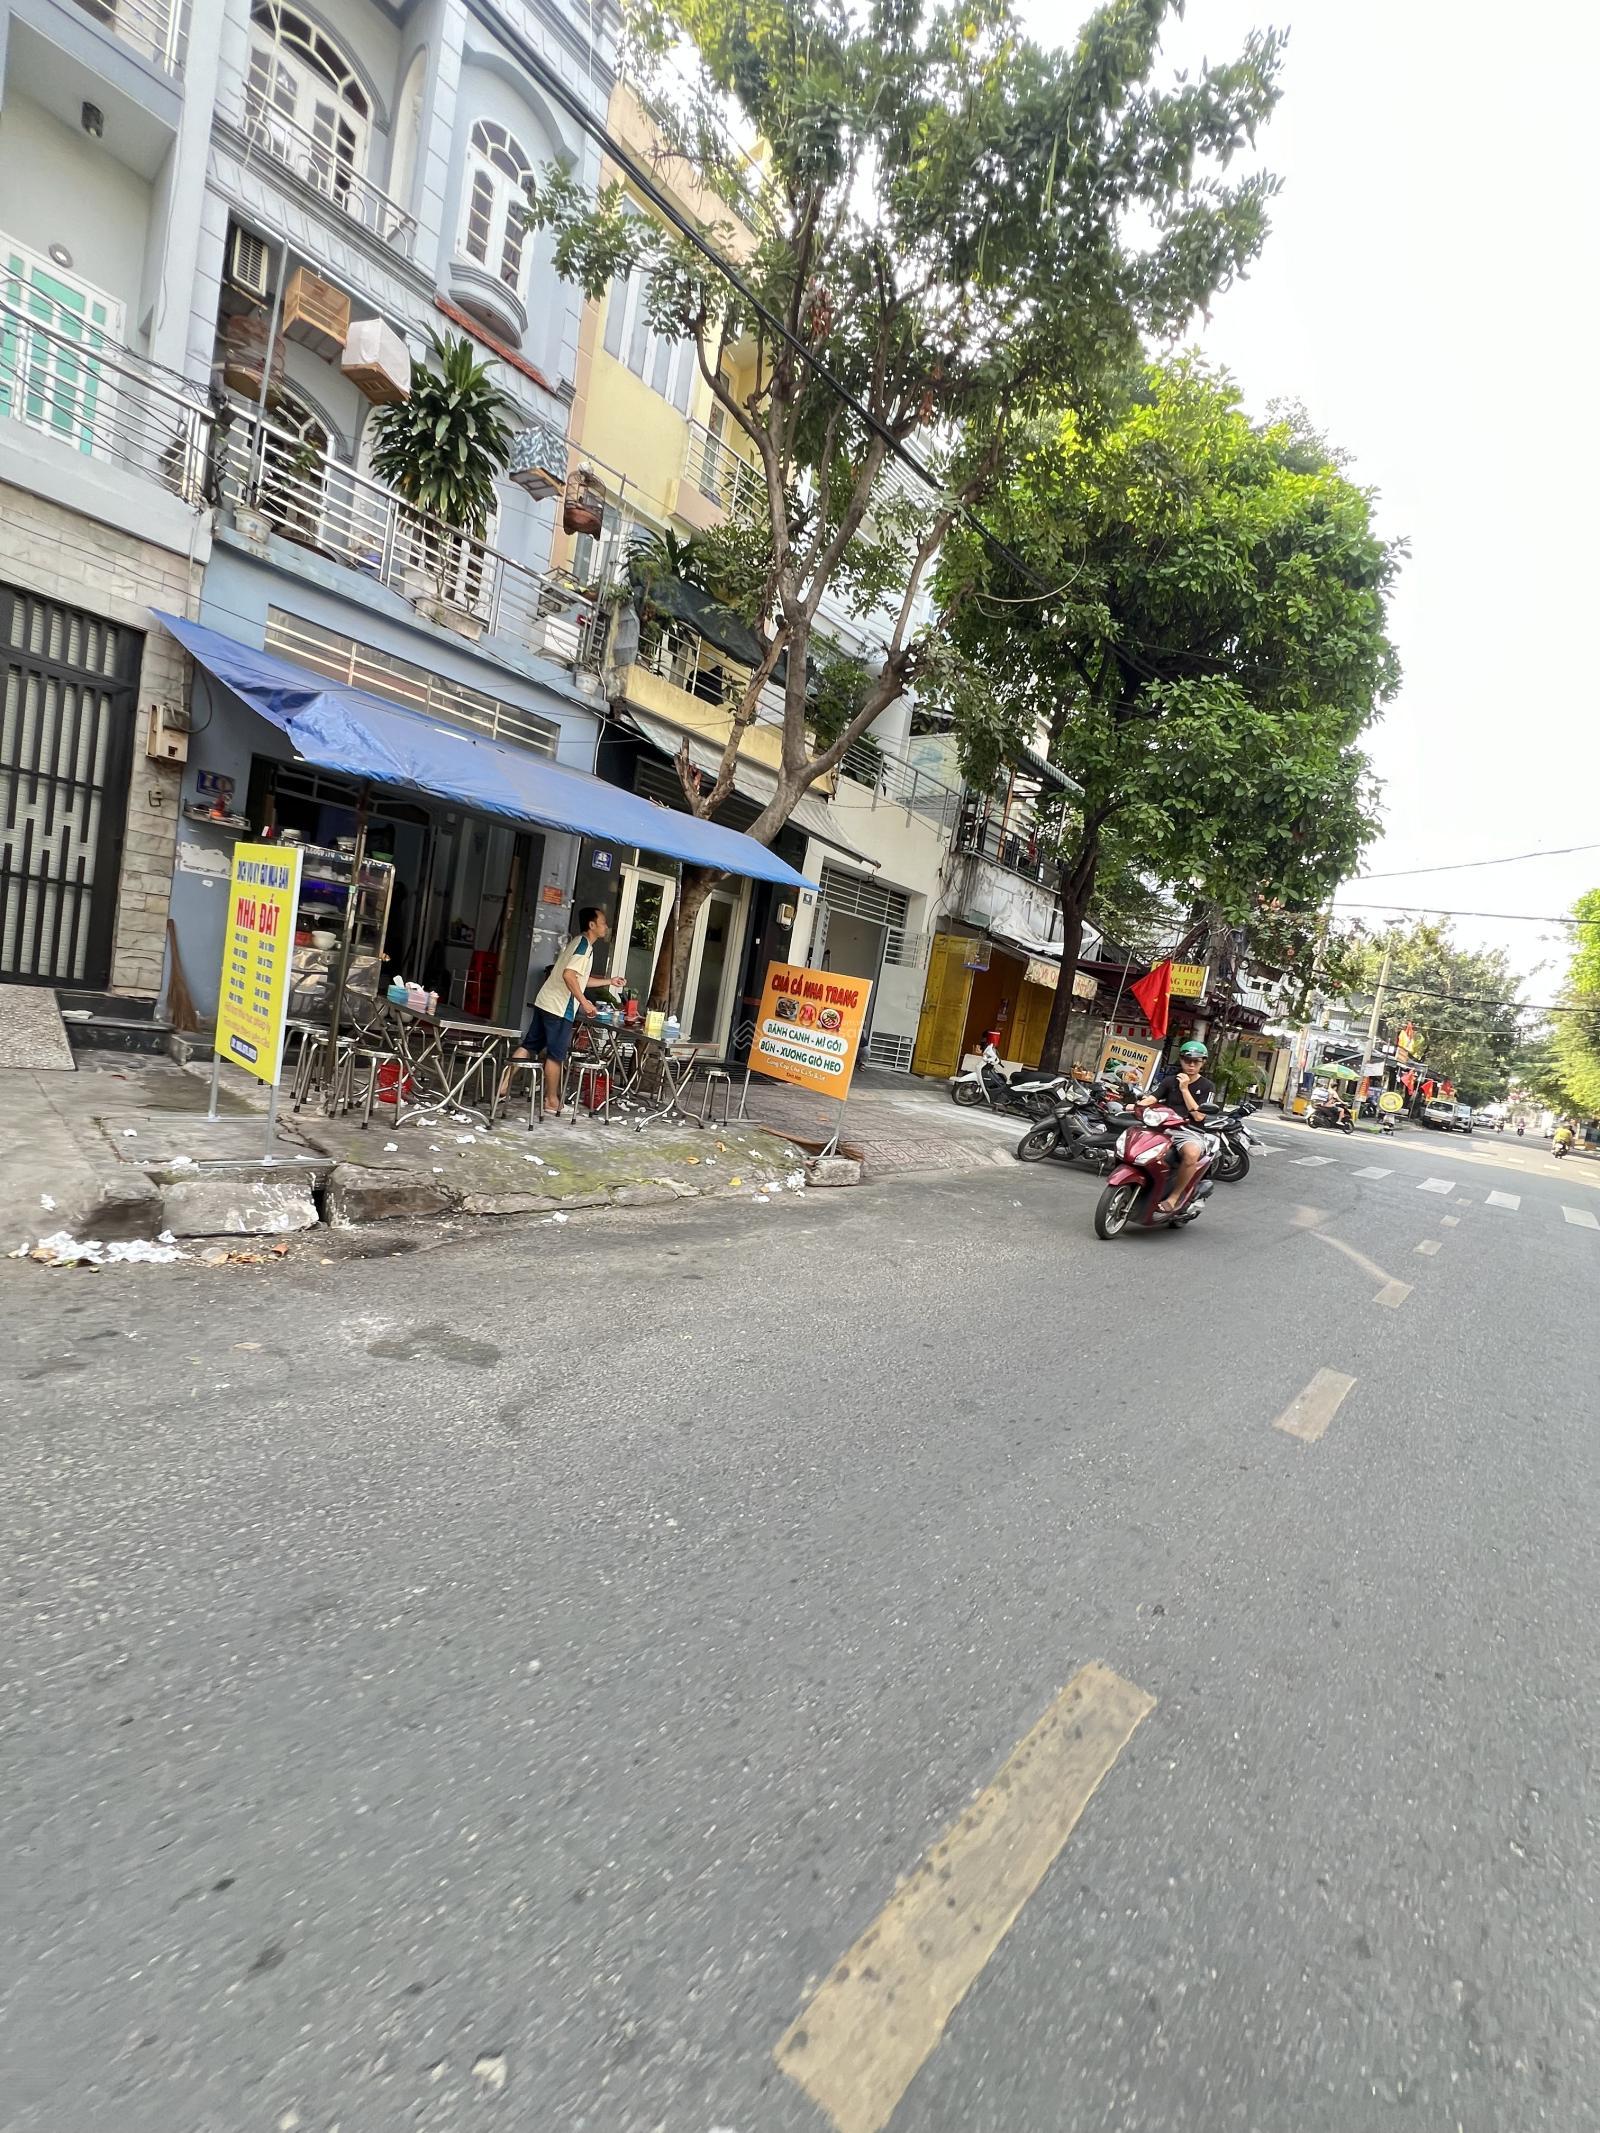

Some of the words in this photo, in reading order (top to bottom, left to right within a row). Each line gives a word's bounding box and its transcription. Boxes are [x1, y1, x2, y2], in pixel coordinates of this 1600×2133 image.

[236, 895, 256, 931] NHÀ
[258, 893, 280, 937] ĐẤT
[790, 974, 803, 997] CÁ
[803, 981, 824, 1002] NHA
[825, 985, 859, 1009] TRANG
[768, 1023, 788, 1038] BÁNH
[788, 1030, 811, 1045] CANH
[815, 1036, 826, 1048] MÌ
[760, 1040, 776, 1053] BÚN
[808, 1053, 823, 1066] GIÒ
[823, 1060, 841, 1073] HEO
